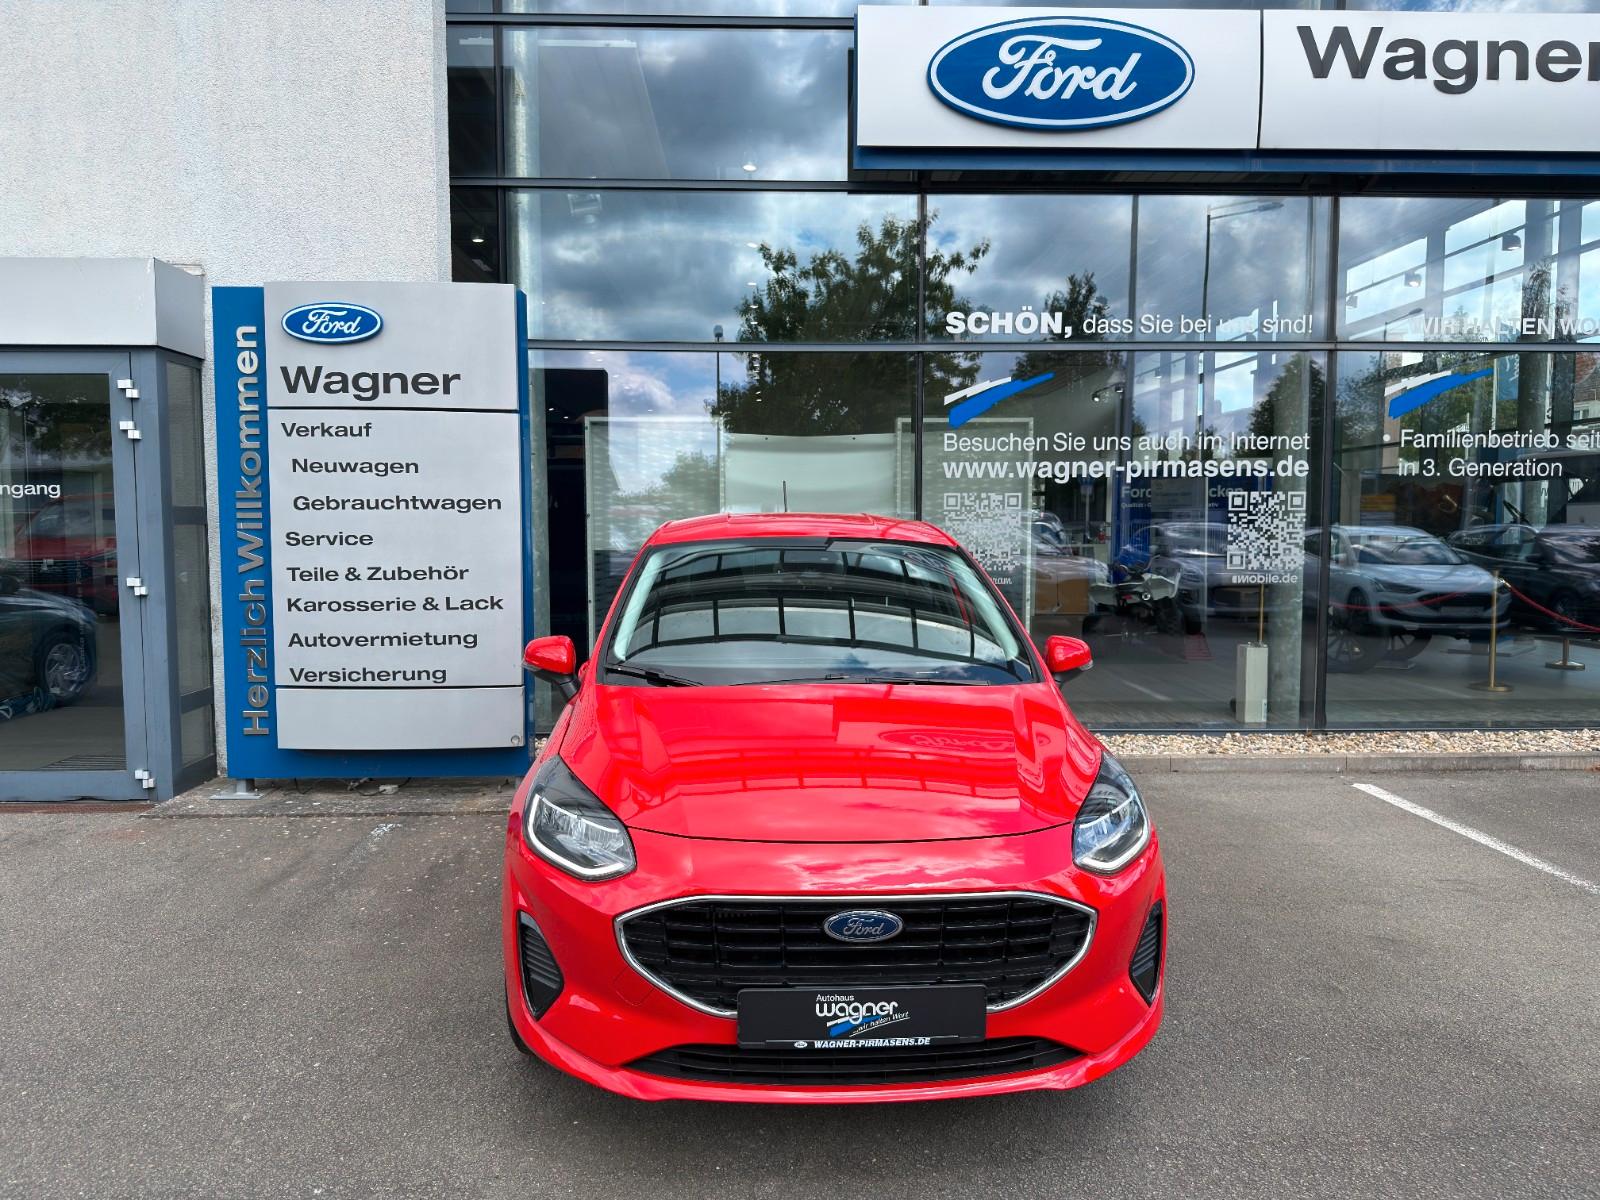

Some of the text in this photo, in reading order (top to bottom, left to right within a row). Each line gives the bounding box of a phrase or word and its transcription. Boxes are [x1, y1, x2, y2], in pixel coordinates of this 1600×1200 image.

[980, 33, 1140, 103] Ford
[301, 307, 362, 336] Ford
[945, 306, 1073, 339] SCHÖN,
[1082, 314, 1133, 334] dass
[1140, 314, 1173, 334] Sie
[1181, 314, 1212, 334] bei
[1263, 313, 1313, 334] sind!
[1559, 316, 1600, 335] WO
[280, 366, 461, 401] Wagner
[281, 422, 372, 437] Verkauf
[1400, 429, 1600, 449] Familienbetrieb seit
[235, 325, 265, 573] Willkommen
[943, 431, 1310, 452] Besuchen Sie uns auch im Internet
[291, 458, 419, 476] Neuwagen
[943, 455, 1310, 483] www.wagner-pirmasens.de
[1398, 457, 1562, 477] in 3. Generation
[292, 495, 501, 513] Gebrauchtwagen
[285, 531, 373, 546] Service
[286, 565, 469, 582] Teile & Zubehör
[287, 595, 503, 613] Karosserie & Lack
[287, 632, 478, 650] Autovermietung
[239, 579, 269, 736] Herzlich
[289, 667, 447, 685] Versicherung
[843, 918, 885, 936] Ford
[816, 994, 855, 1002] Autohaus
[815, 1001, 899, 1025] wagner
[814, 1037, 931, 1048] WAGNER-PIRMASENS.DE
